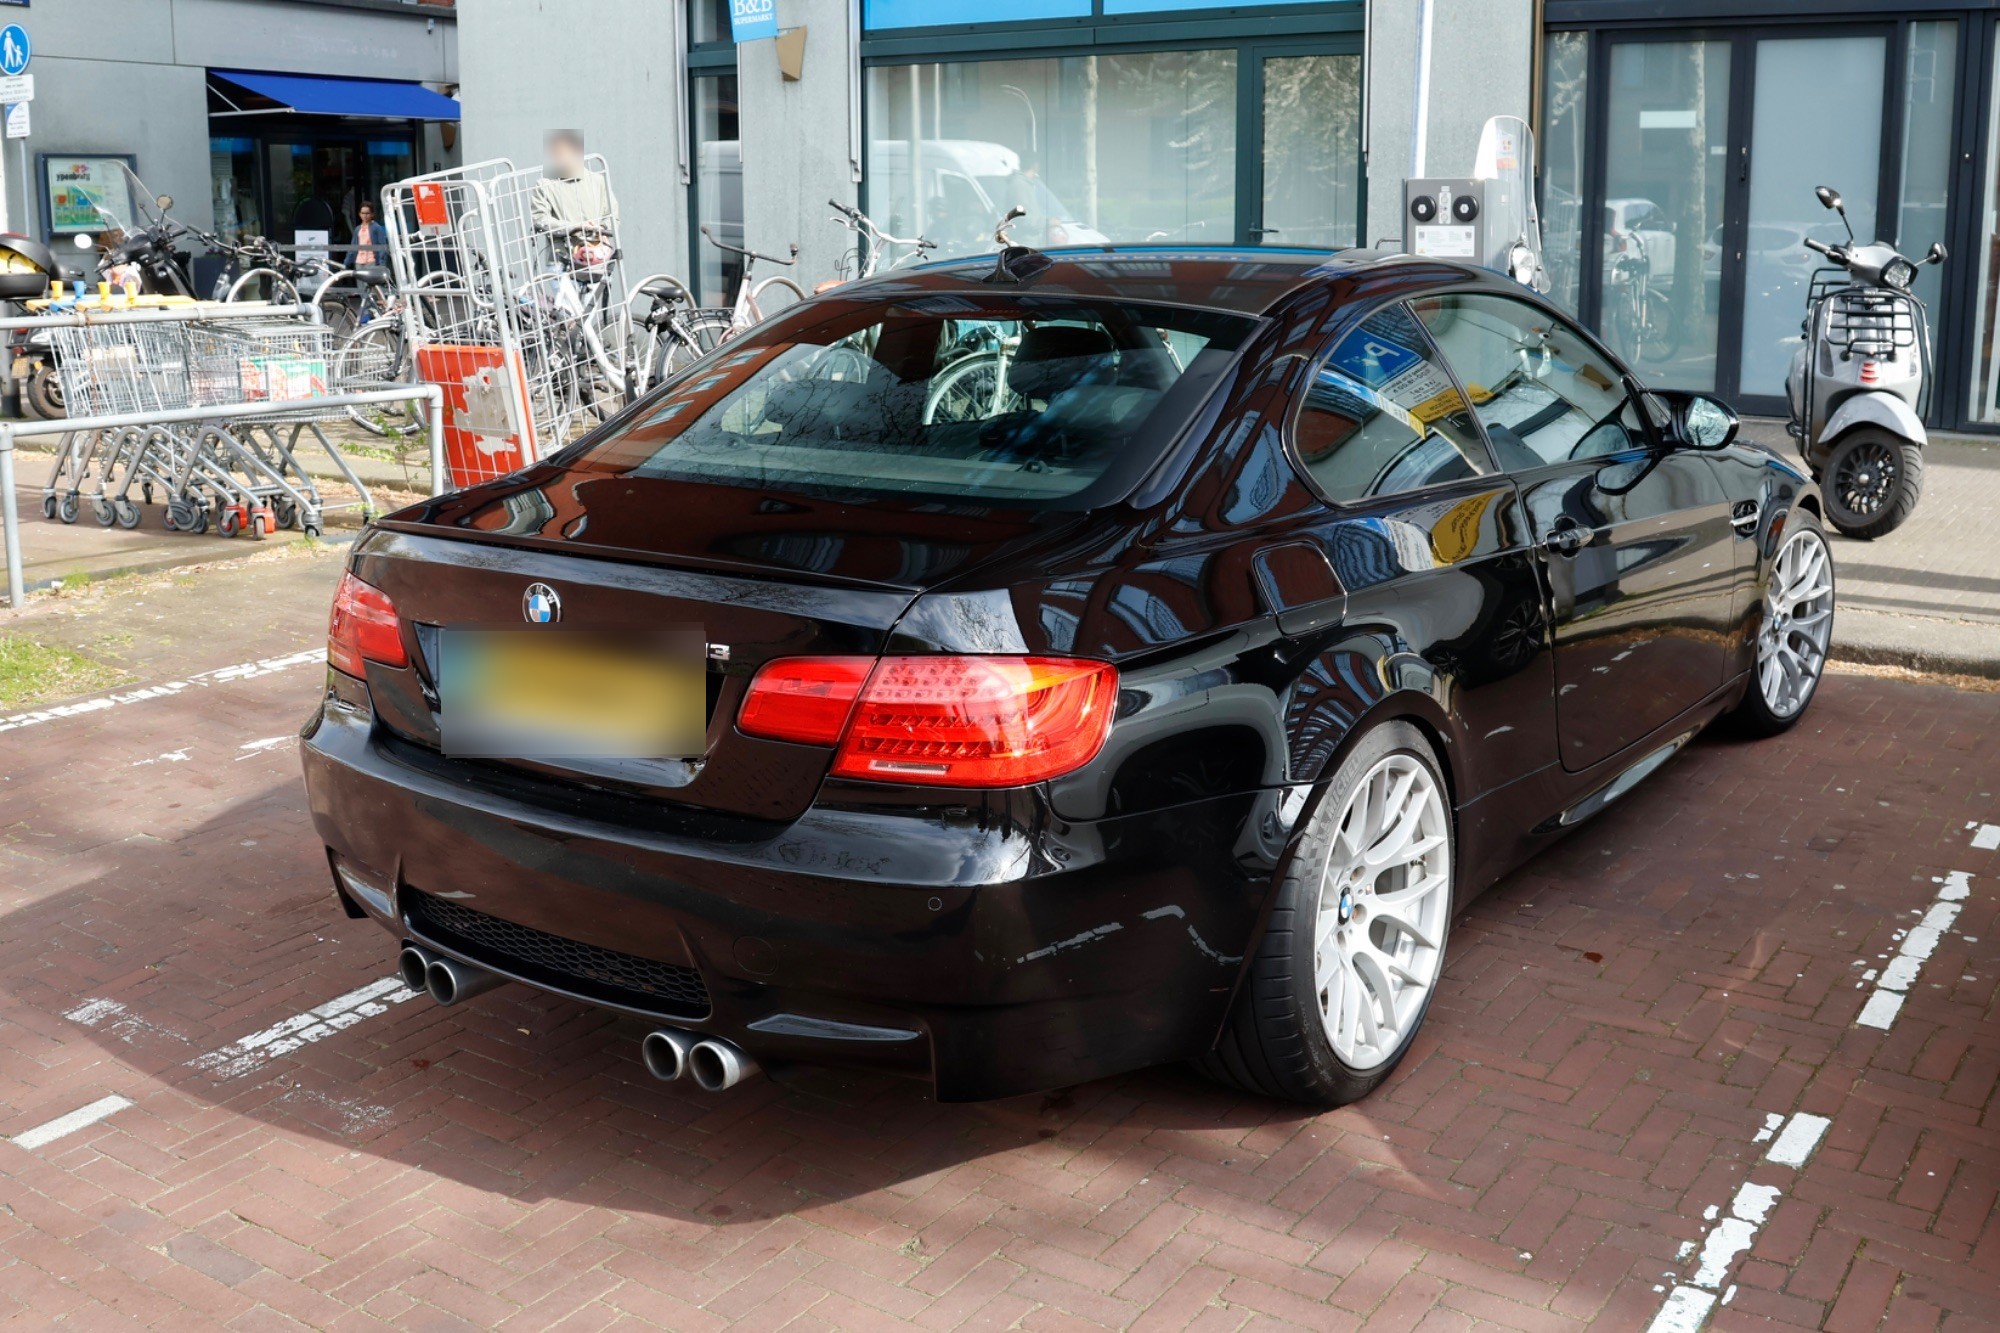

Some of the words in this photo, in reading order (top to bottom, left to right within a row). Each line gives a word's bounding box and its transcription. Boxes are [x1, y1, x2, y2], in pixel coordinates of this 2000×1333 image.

[734, 0, 773, 16] B&B
[733, 13, 773, 25] SUPERMARKT
[705, 642, 730, 661] 3
